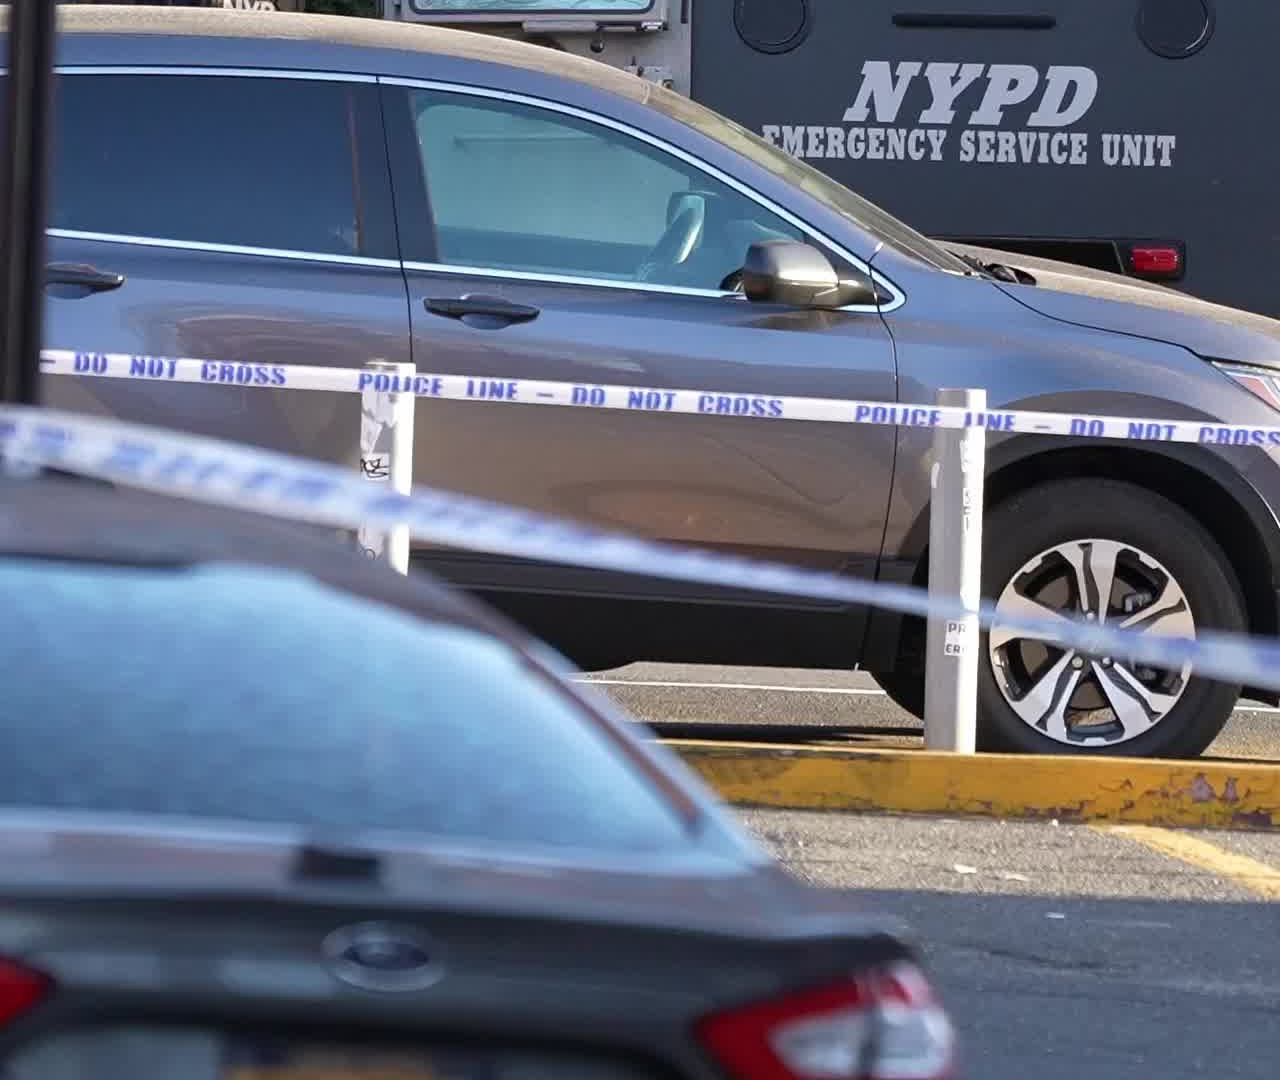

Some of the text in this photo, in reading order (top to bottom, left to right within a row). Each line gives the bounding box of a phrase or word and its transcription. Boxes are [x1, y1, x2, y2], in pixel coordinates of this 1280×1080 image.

[842, 60, 1098, 127] NYPD
[762, 124, 1176, 167] EMERGENCY SERVICE UNIT
[73, 352, 108, 374] DO
[130, 357, 177, 379] NOT
[200, 361, 286, 385] CROSS
[358, 373, 443, 396] POLICE
[467, 380, 518, 400] LINE
[571, 386, 606, 406] DO
[628, 390, 677, 411] NOT
[698, 395, 784, 417] CROSS
[855, 405, 943, 426] POLICE
[964, 411, 1017, 431] LINE
[1071, 418, 1105, 438] DO
[1128, 422, 1177, 441] NOT
